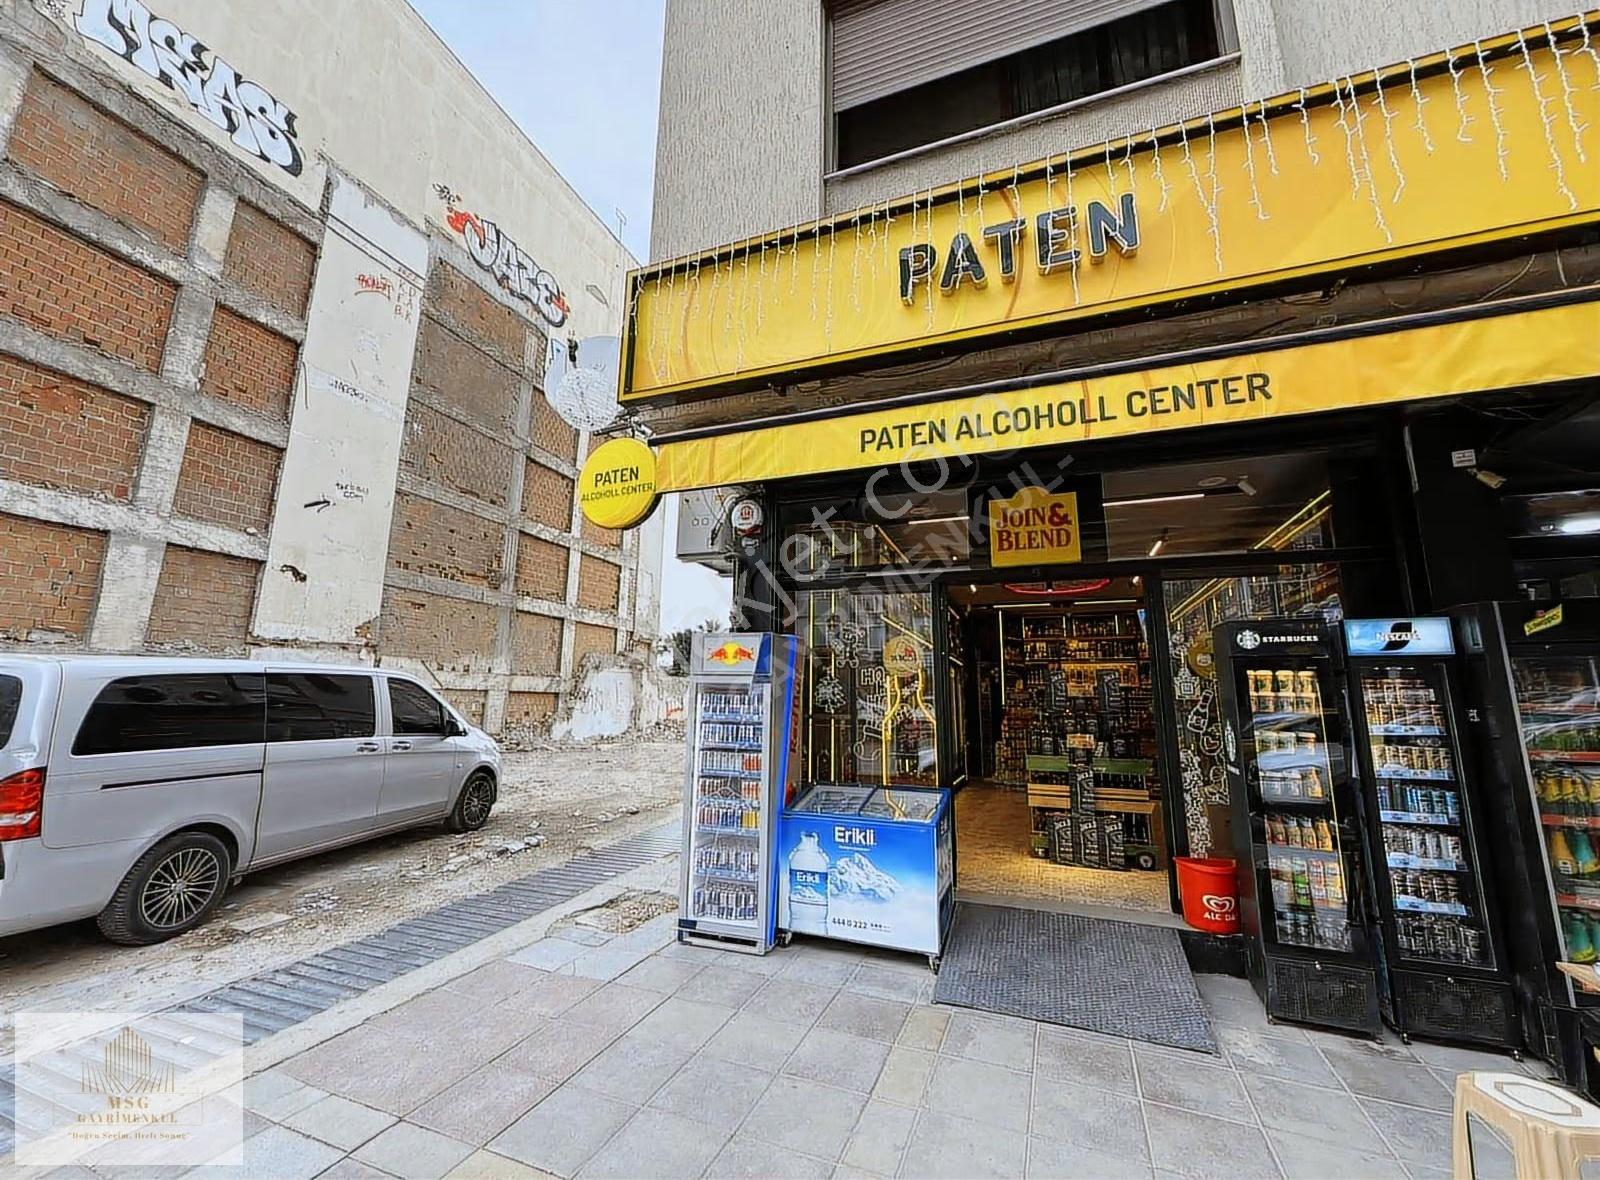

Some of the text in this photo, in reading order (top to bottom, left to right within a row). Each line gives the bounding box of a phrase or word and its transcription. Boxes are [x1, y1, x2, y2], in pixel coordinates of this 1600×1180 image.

[898, 192, 1140, 305] PATEN
[859, 372, 1273, 453] PATEN ALCOHOLL CENTER
[594, 466, 639, 488] PATEN
[620, 482, 653, 496] CENTER
[996, 528, 1072, 552] BLEND
[1262, 635, 1319, 643] STARBUCKS
